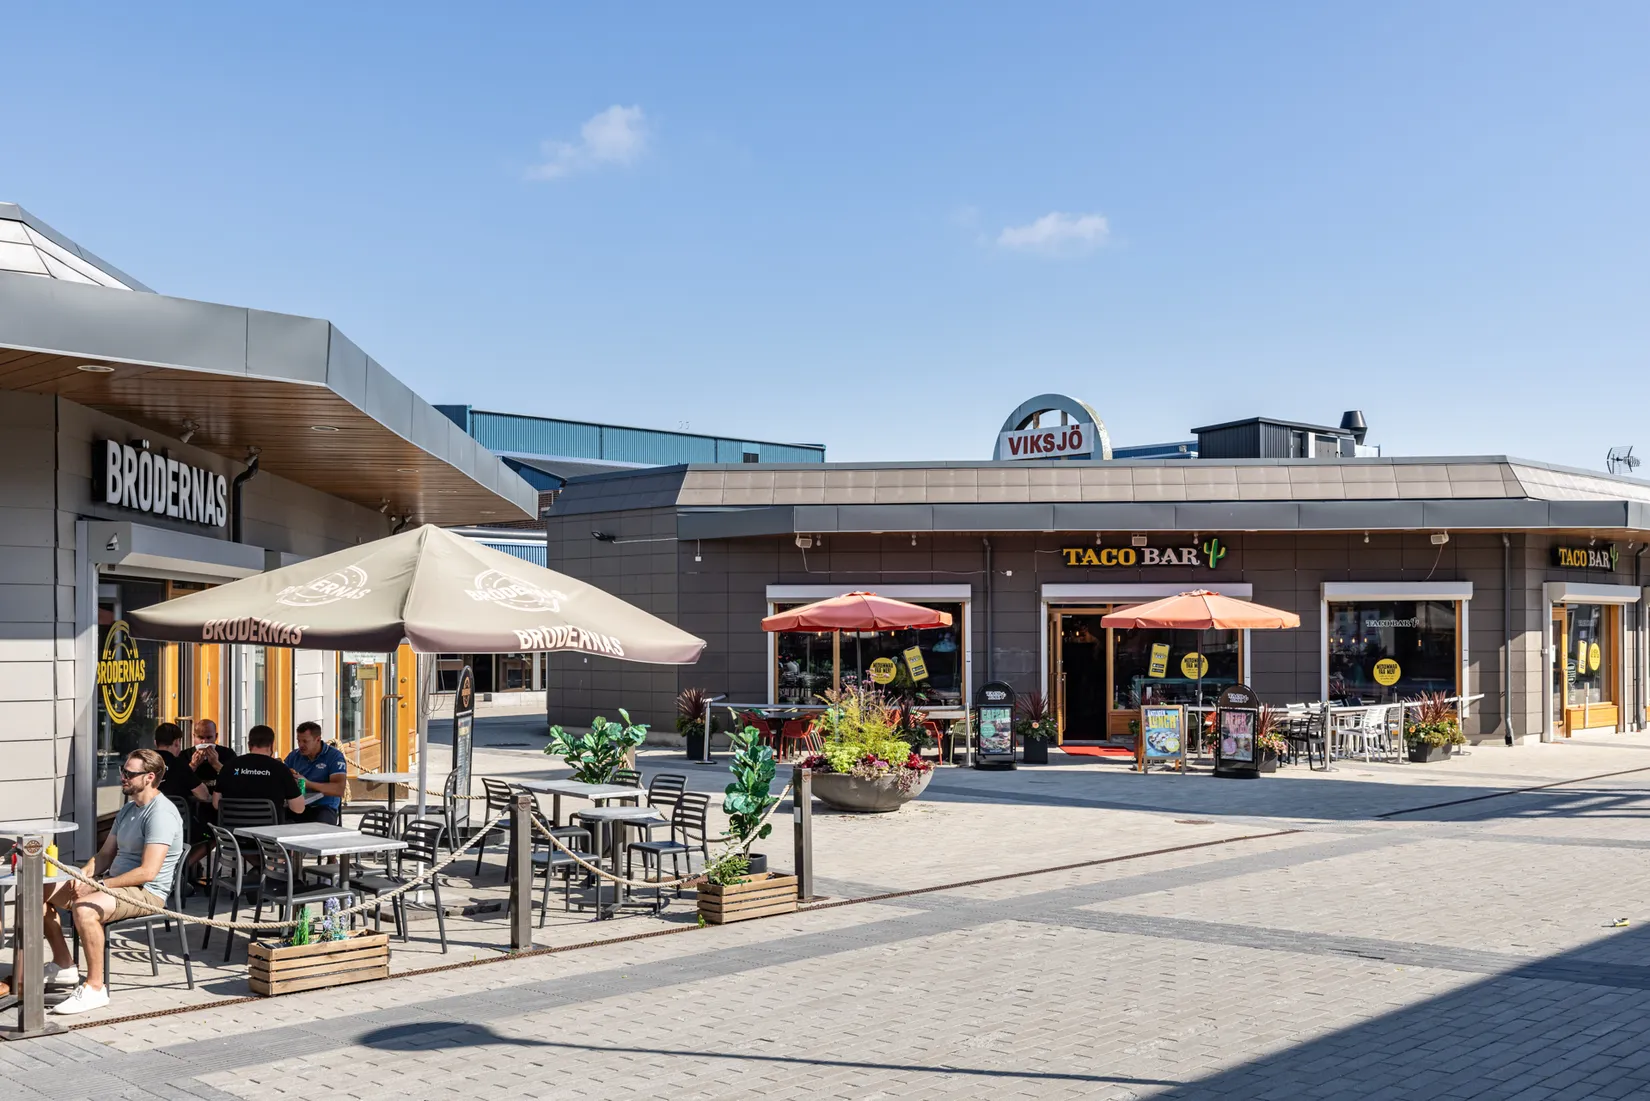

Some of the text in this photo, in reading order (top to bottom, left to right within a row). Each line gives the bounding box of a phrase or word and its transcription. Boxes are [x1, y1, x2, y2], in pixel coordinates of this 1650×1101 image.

[1008, 424, 1083, 456] VIKSJÖ
[106, 439, 227, 527] BRÖDERNAS
[1063, 547, 1200, 566] TACO BAR
[1558, 548, 1610, 569] TACO BAR
[1149, 715, 1177, 728] LUNCH
[240, 767, 271, 777] kimtech
